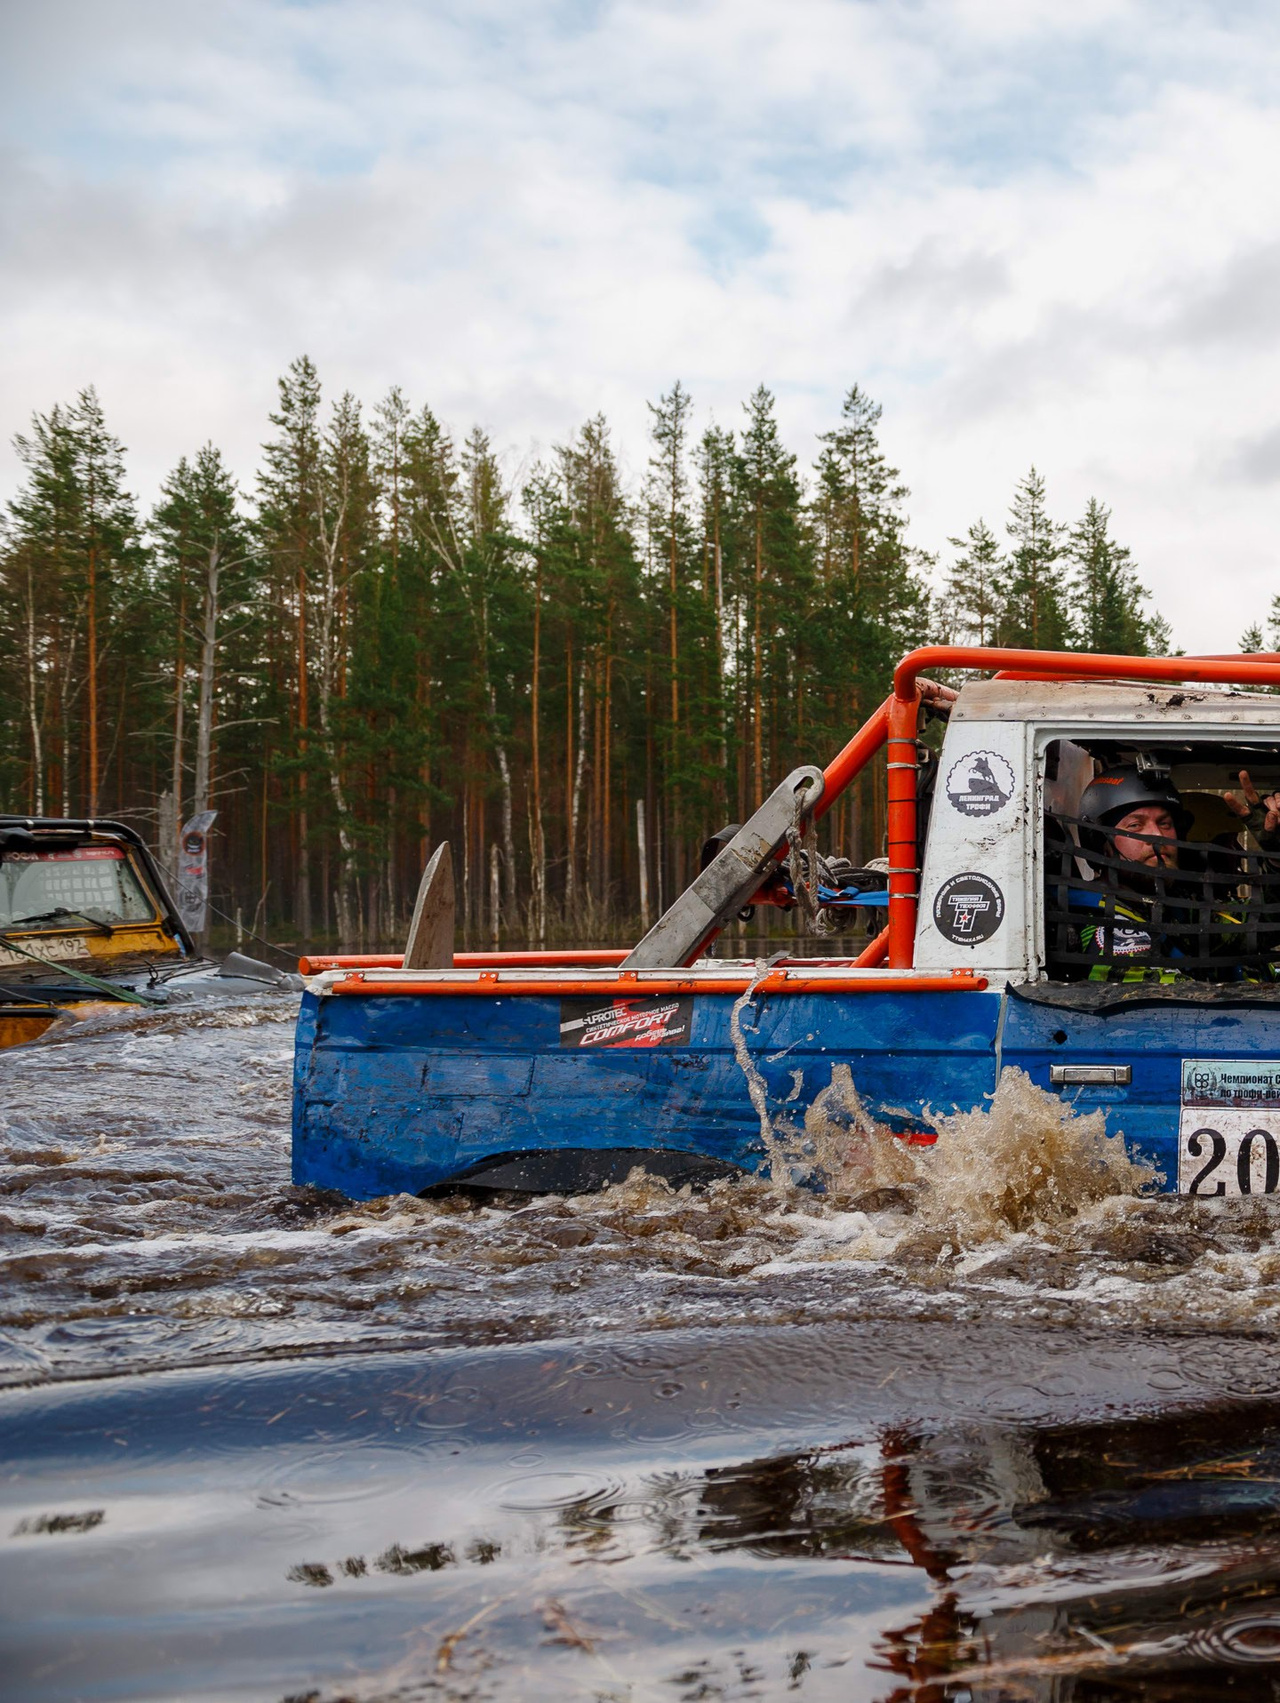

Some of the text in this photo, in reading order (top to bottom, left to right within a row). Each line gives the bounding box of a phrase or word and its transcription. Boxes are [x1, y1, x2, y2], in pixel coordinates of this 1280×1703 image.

[583, 1007, 627, 1026] SUPROTEC
[631, 1007, 660, 1021] МОТОРНОЕ
[580, 1009, 678, 1045] COMFORT
[1220, 1073, 1274, 1087] Чемпионат
[1220, 1090, 1232, 1098] по
